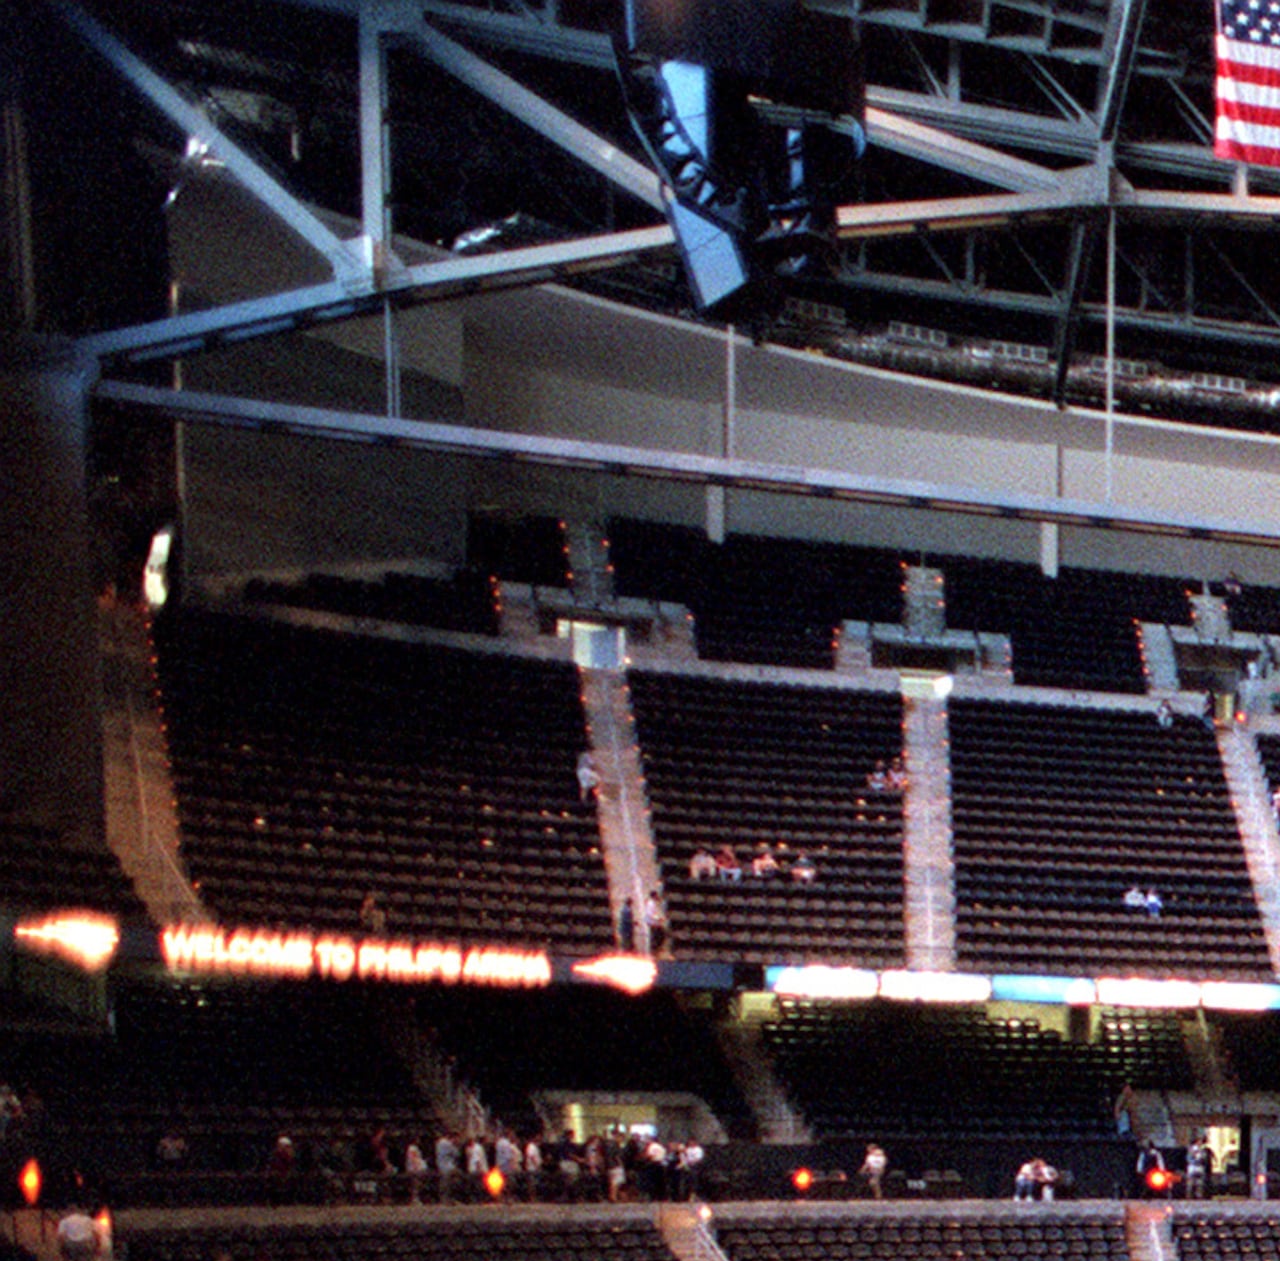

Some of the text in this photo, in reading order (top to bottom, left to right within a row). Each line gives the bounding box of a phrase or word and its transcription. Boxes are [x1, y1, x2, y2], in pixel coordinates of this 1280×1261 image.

[162, 926, 551, 984] WELCOME TO PHILIPS ARENA
